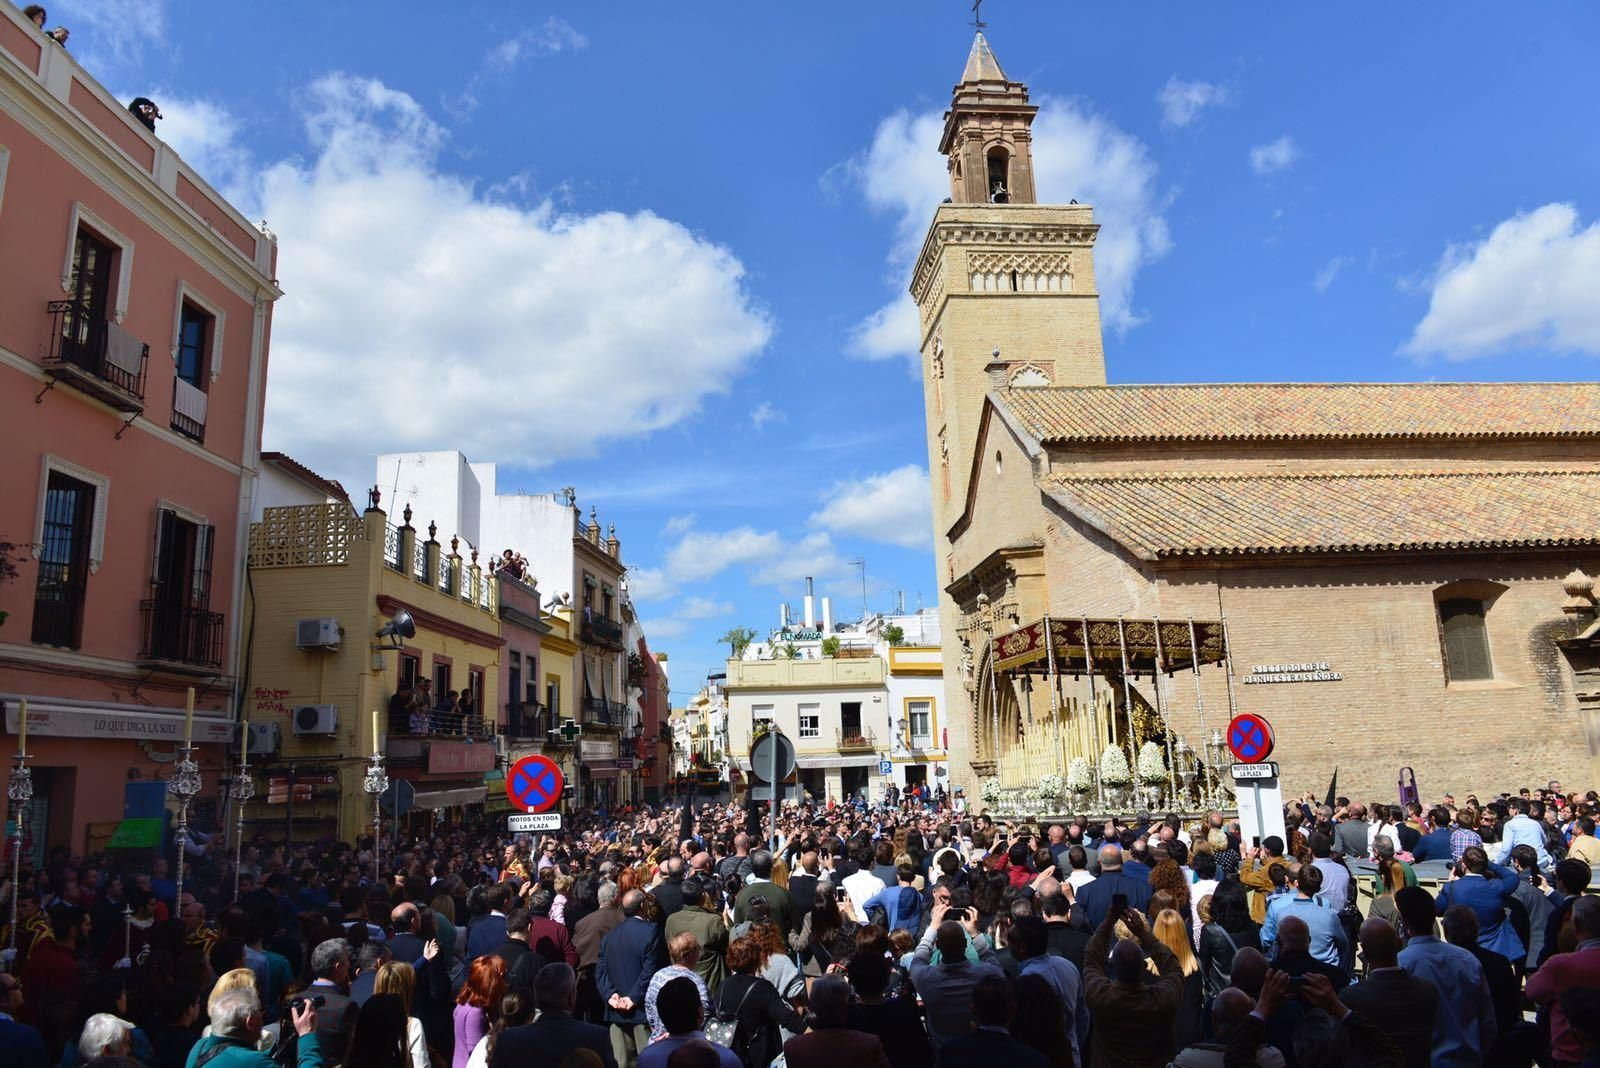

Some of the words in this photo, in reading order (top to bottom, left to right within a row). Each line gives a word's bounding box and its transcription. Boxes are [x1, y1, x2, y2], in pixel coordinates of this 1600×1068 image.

[1286, 662, 1330, 671] DOLORES
[1258, 674, 1302, 683] NUESTRA
[1304, 671, 1342, 681] SEÑORA
[94, 720, 106, 730] LO
[108, 720, 124, 732] QUE
[127, 722, 146, 732] DIGA
[148, 722, 158, 733] LA
[160, 724, 176, 734] SOLE
